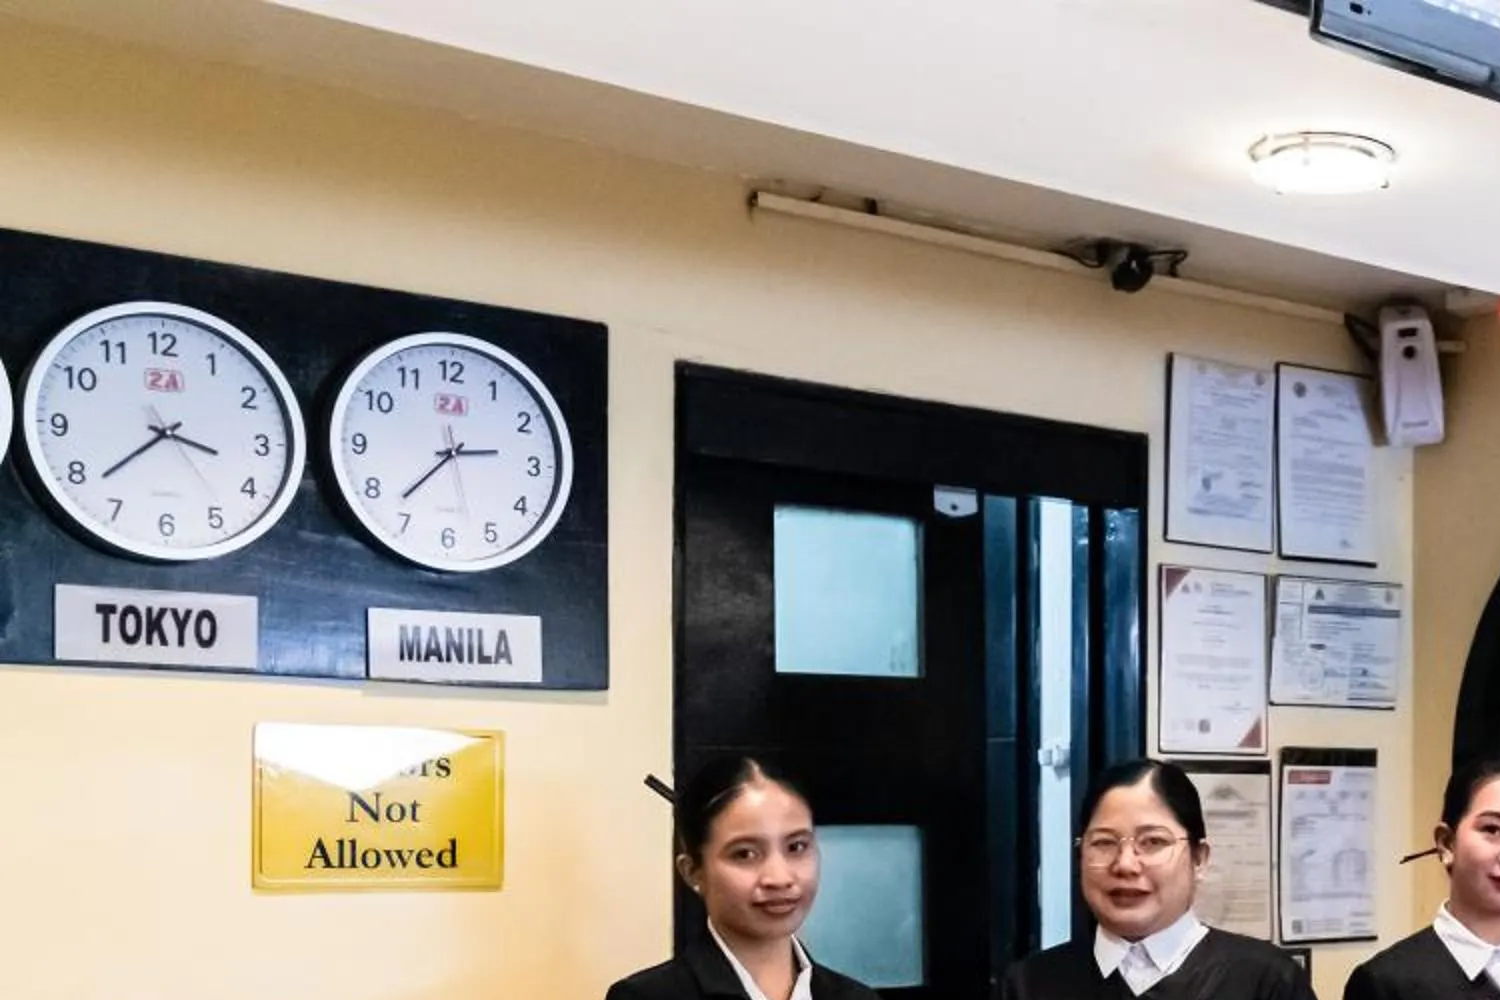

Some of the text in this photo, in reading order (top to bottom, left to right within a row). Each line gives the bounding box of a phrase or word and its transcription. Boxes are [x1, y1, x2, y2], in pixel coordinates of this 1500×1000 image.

[99, 339, 126, 365] 11
[147, 331, 178, 358] 12
[205, 352, 217, 376] 1
[437, 359, 465, 385] 12
[63, 365, 97, 392] 10
[397, 366, 420, 390] 11
[487, 379, 498, 401] 1
[240, 386, 257, 409] 2
[364, 389, 394, 414] 10
[50, 413, 69, 438] 9
[517, 411, 532, 434] 2
[254, 434, 271, 457] 3
[351, 432, 368, 455] 9
[67, 460, 87, 485] 8
[527, 456, 541, 478] 3
[240, 477, 257, 499] 4
[364, 476, 382, 500] 8
[107, 498, 123, 522] 7
[207, 506, 224, 530] 5
[513, 495, 528, 517] 4
[157, 512, 176, 537] 6
[399, 513, 412, 535] 7
[484, 521, 498, 544] 5
[440, 527, 456, 550] 6
[95, 603, 218, 649] TOKYO
[399, 626, 513, 665] MANILA
[346, 792, 421, 824] Not
[304, 838, 459, 870] Allowed
